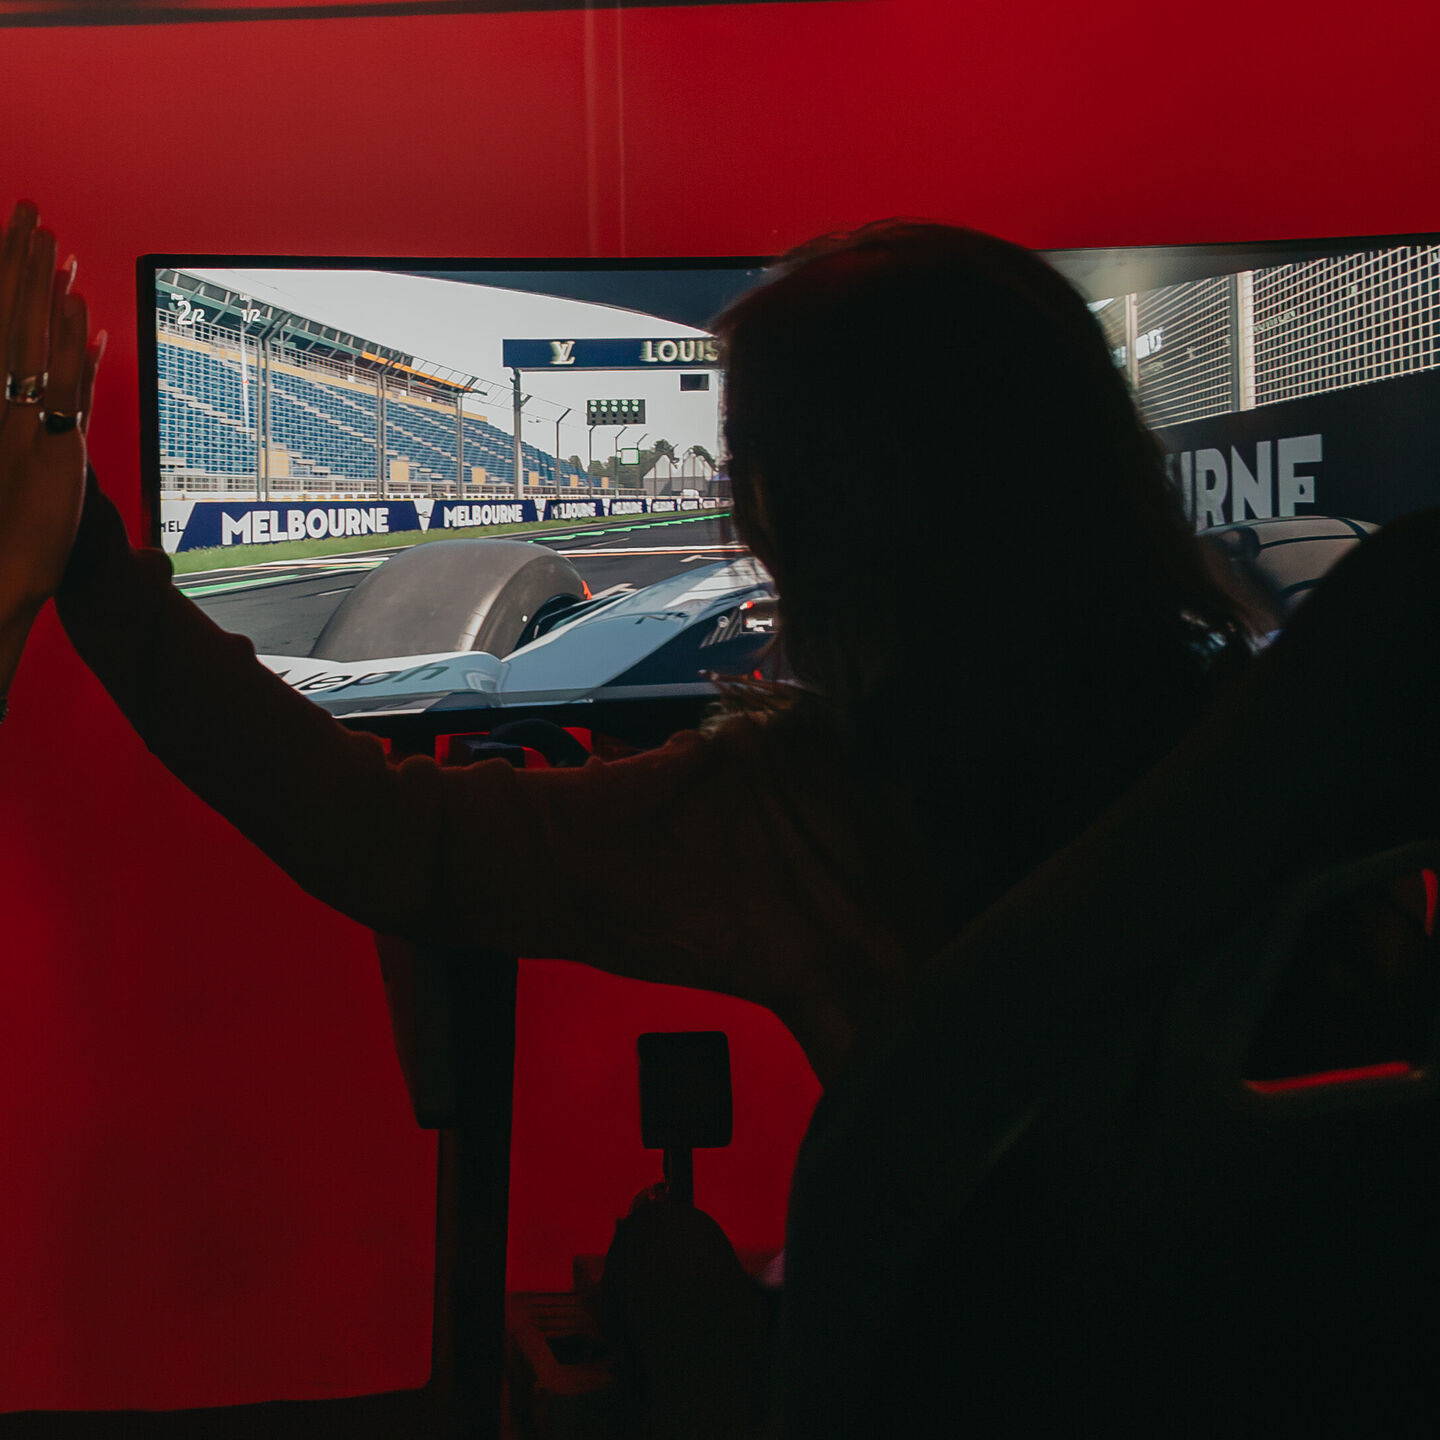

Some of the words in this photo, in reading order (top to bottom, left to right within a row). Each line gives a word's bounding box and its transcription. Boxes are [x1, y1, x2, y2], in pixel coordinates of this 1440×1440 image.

[642, 340, 720, 362] LOUIS
[221, 507, 390, 546] MELBOURNE
[444, 504, 523, 528] MELBOURNE
